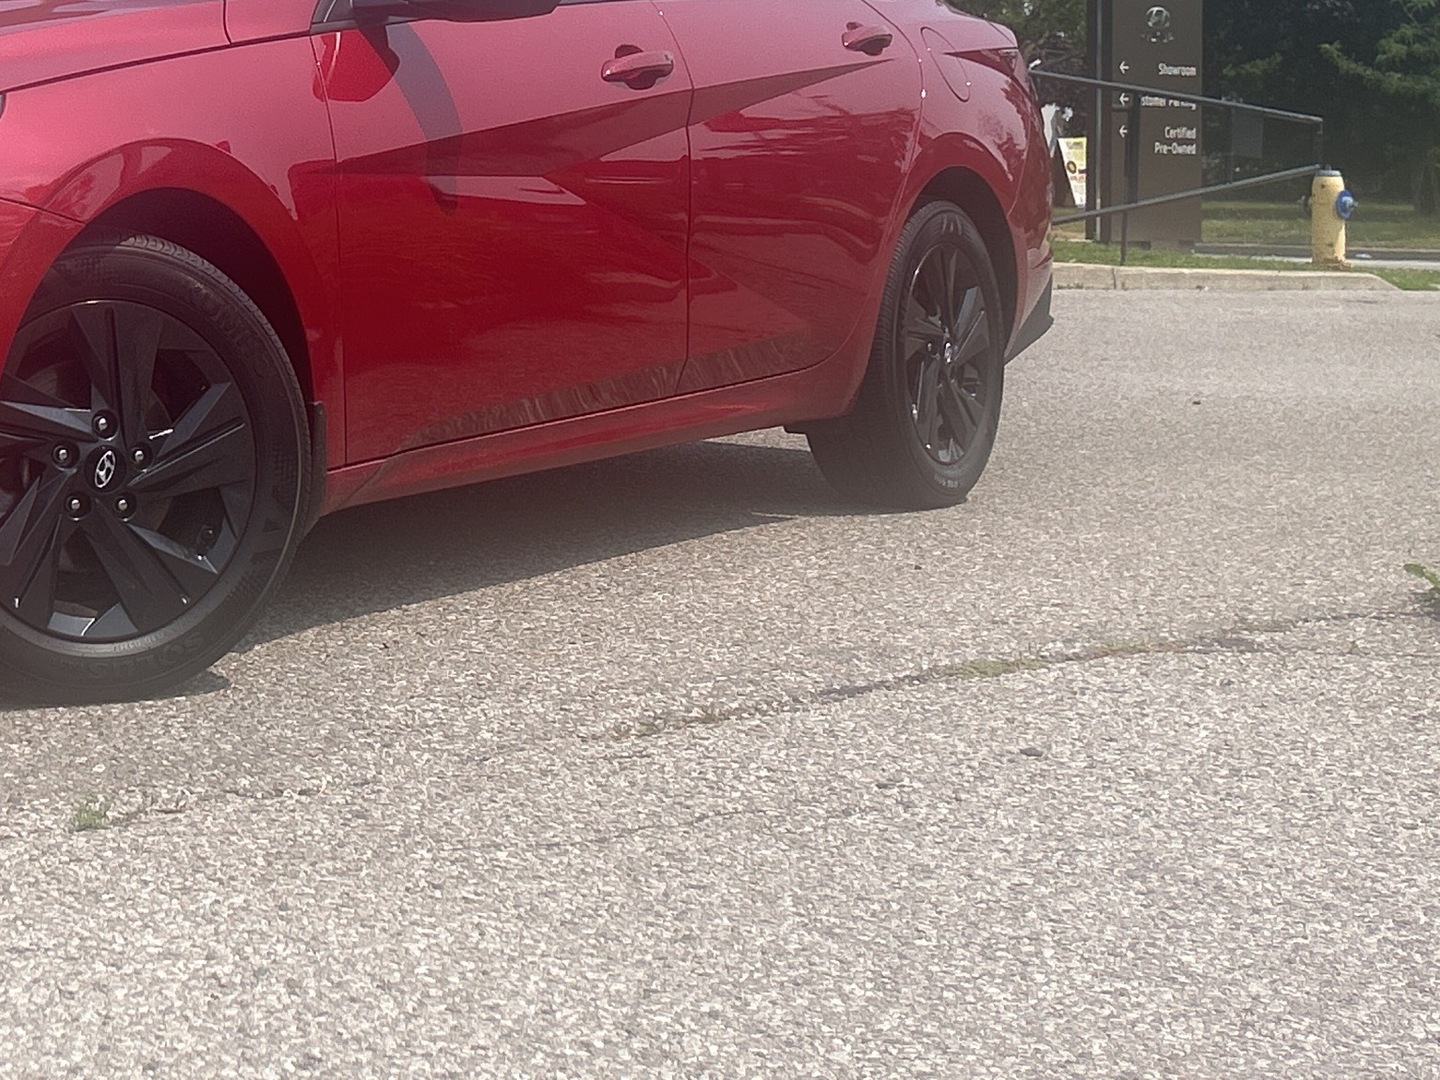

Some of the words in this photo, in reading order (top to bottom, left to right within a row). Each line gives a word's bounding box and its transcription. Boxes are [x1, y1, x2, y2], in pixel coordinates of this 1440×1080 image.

[1158, 62, 1197, 77] Showroom
[1164, 126, 1197, 139] Certified
[1153, 141, 1197, 155] Pre-Owned
